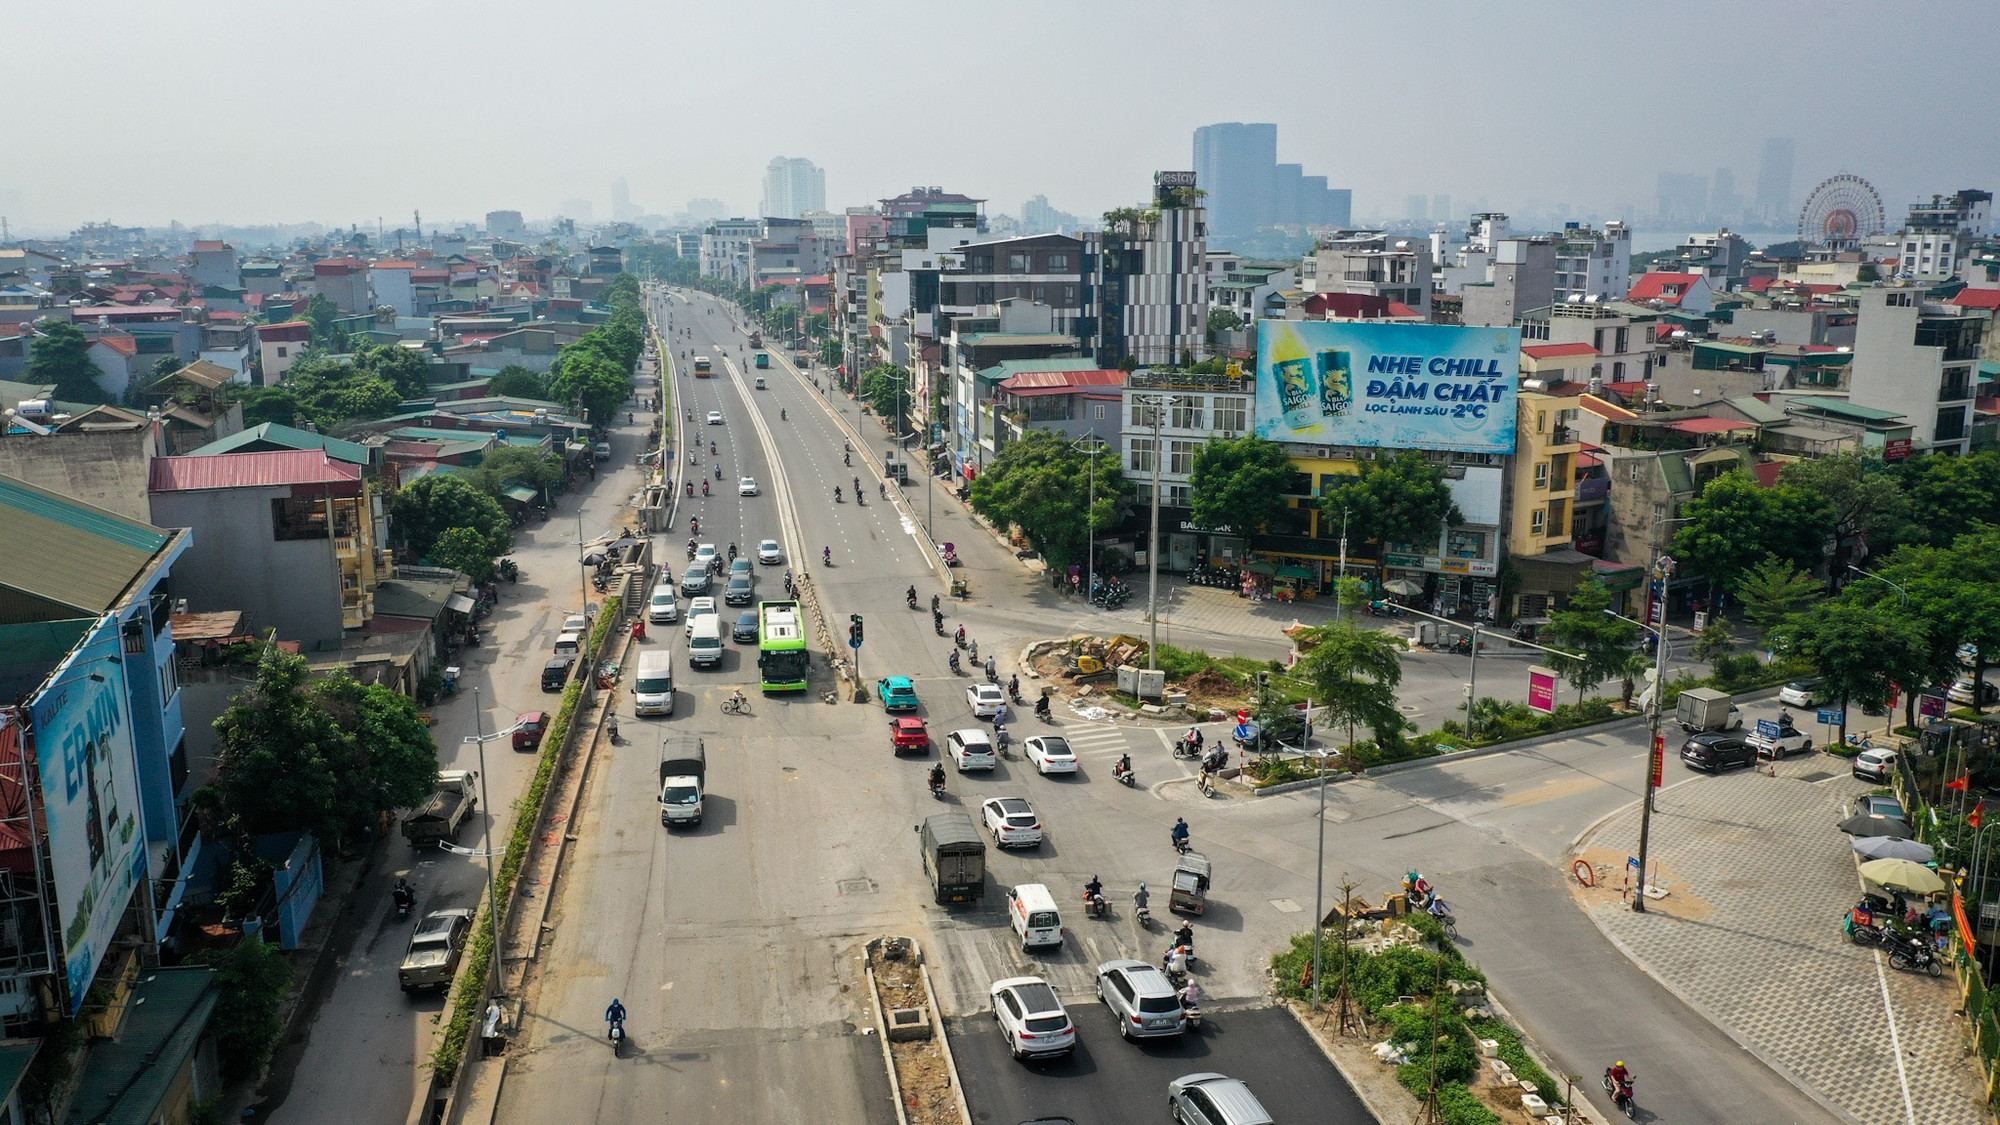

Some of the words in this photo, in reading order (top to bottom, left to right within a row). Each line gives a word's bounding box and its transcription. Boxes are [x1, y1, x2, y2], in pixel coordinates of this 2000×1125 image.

[1367, 354, 1424, 380] NHẸ
[1428, 356, 1503, 378] CHILL
[1366, 376, 1430, 404] ĐẬM
[1434, 377, 1509, 403] CHẤT
[1365, 403, 1388, 415] LỌC
[1390, 404, 1423, 416] LẠNH
[1423, 404, 1449, 416] SÂU
